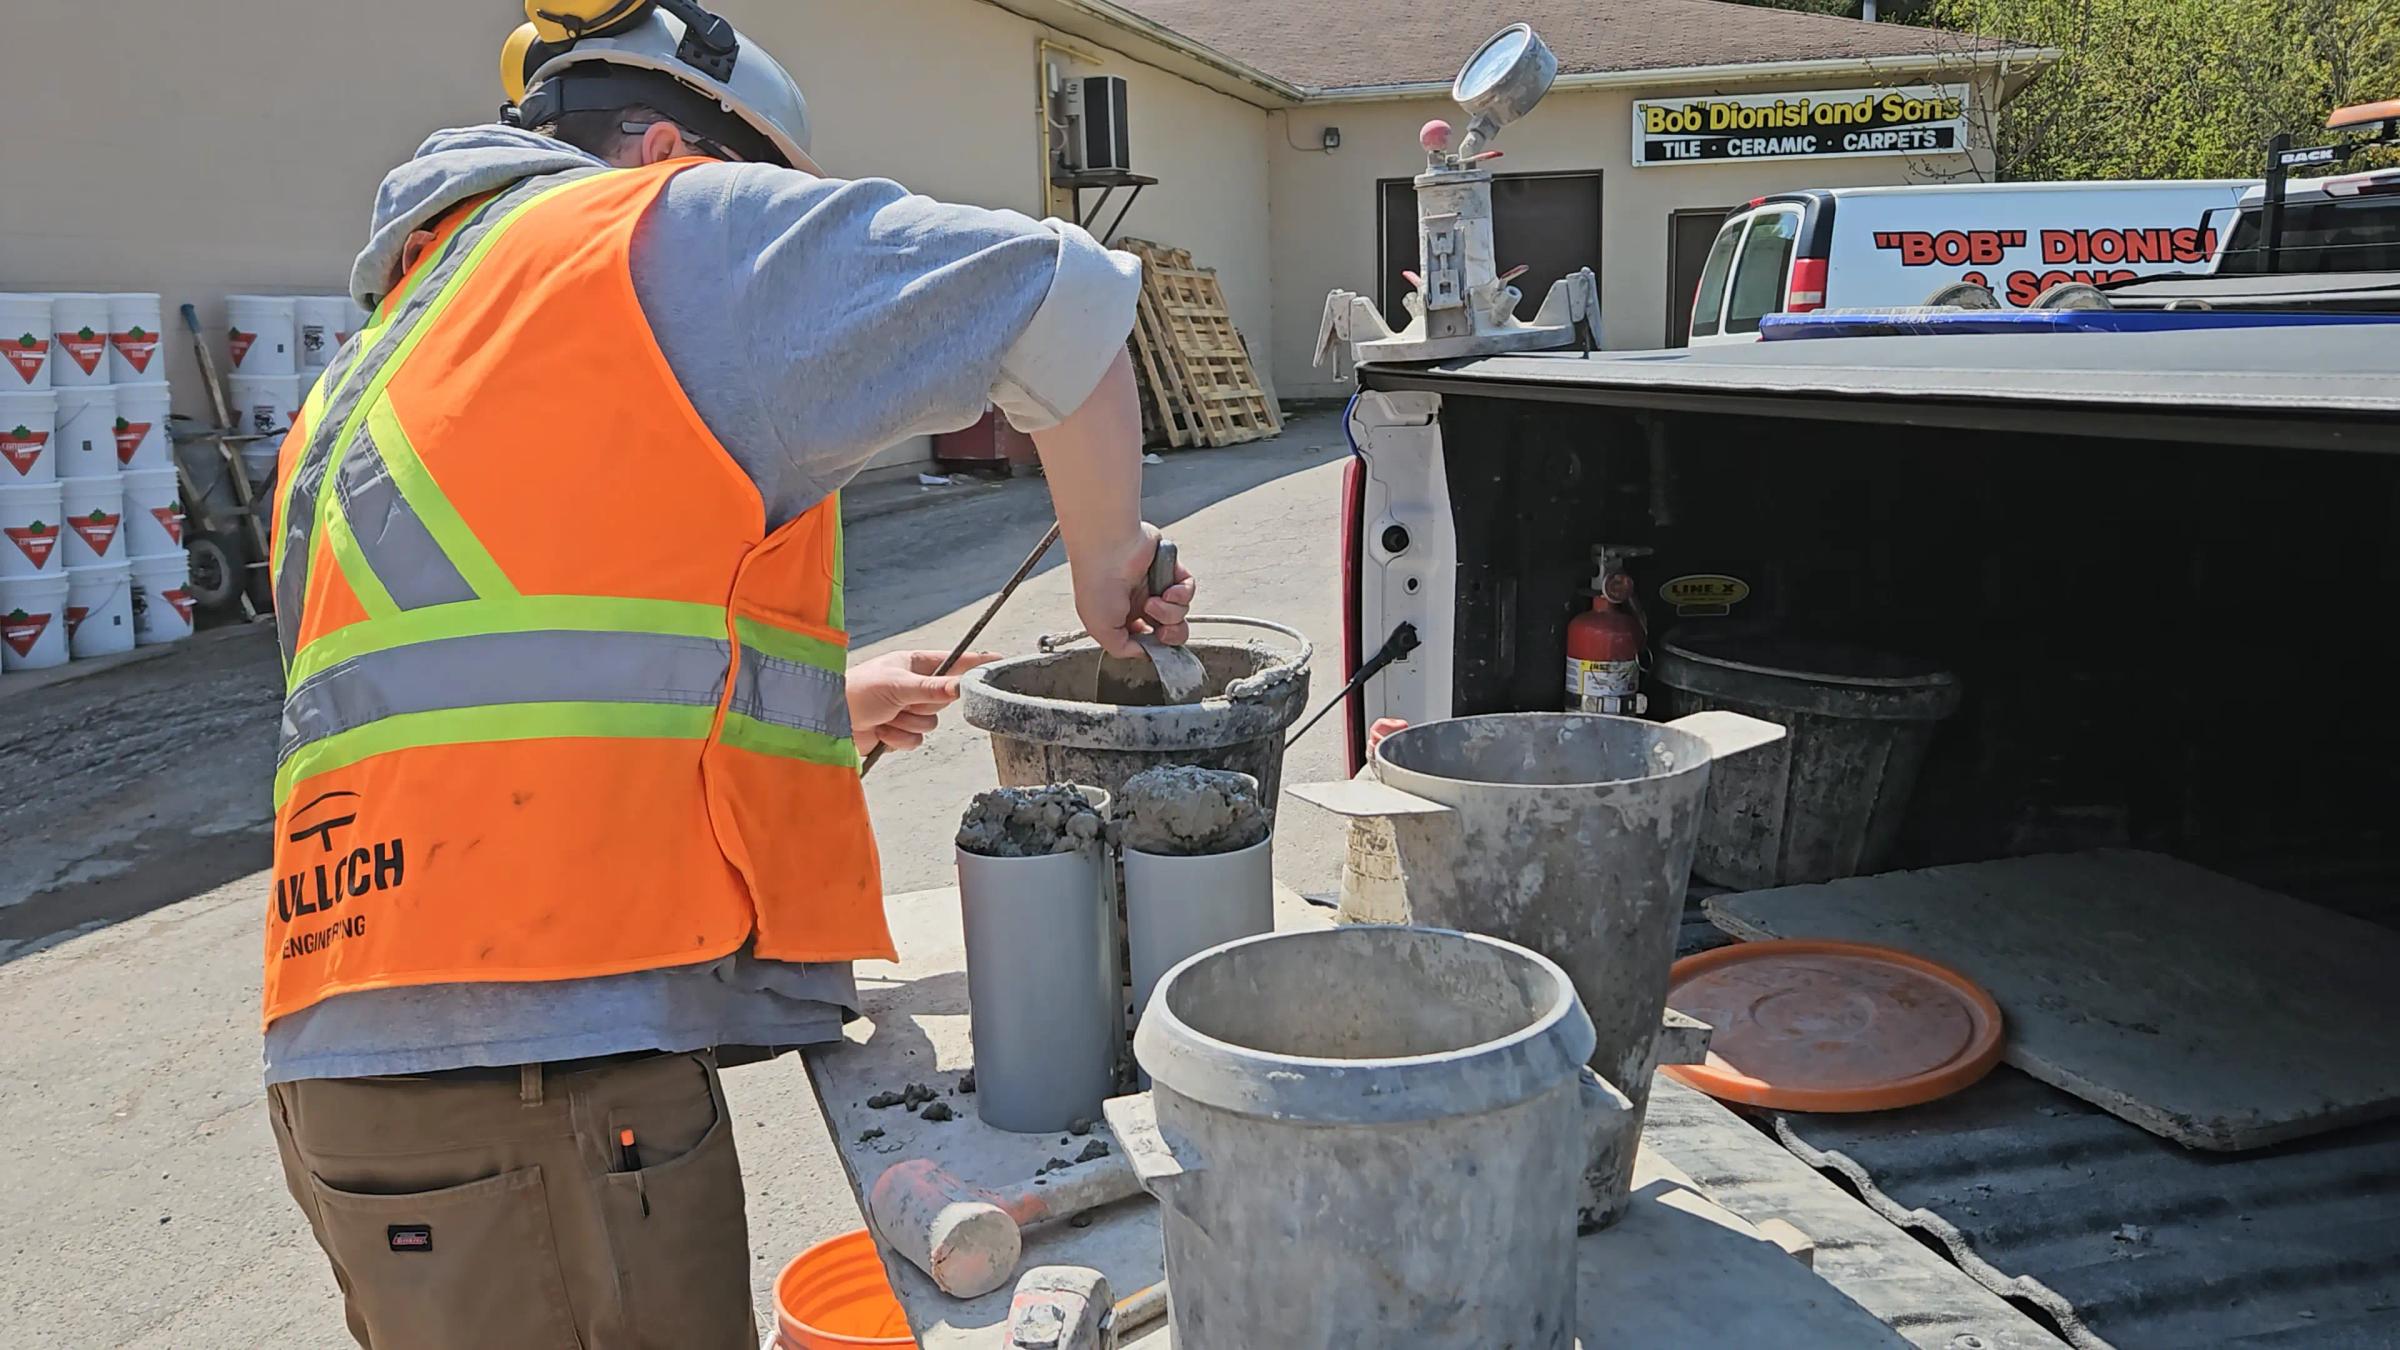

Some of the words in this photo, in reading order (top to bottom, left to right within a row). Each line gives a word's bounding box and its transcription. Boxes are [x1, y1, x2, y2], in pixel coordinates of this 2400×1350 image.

[1640, 101, 1707, 133] "Bob"
[1709, 98, 1810, 130] Dionisi
[1814, 95, 1874, 125] and
[1881, 94, 1961, 122] Sons
[1663, 141, 1701, 158] TILE
[1727, 135, 1817, 155] CERAMIC
[1843, 130, 1937, 150] CARPETS
[2281, 149, 2334, 164] BACK
[1873, 230, 2027, 266] "BOB"
[2040, 228, 2218, 264] DIONISI
[274, 838, 405, 923] ULLOCH
